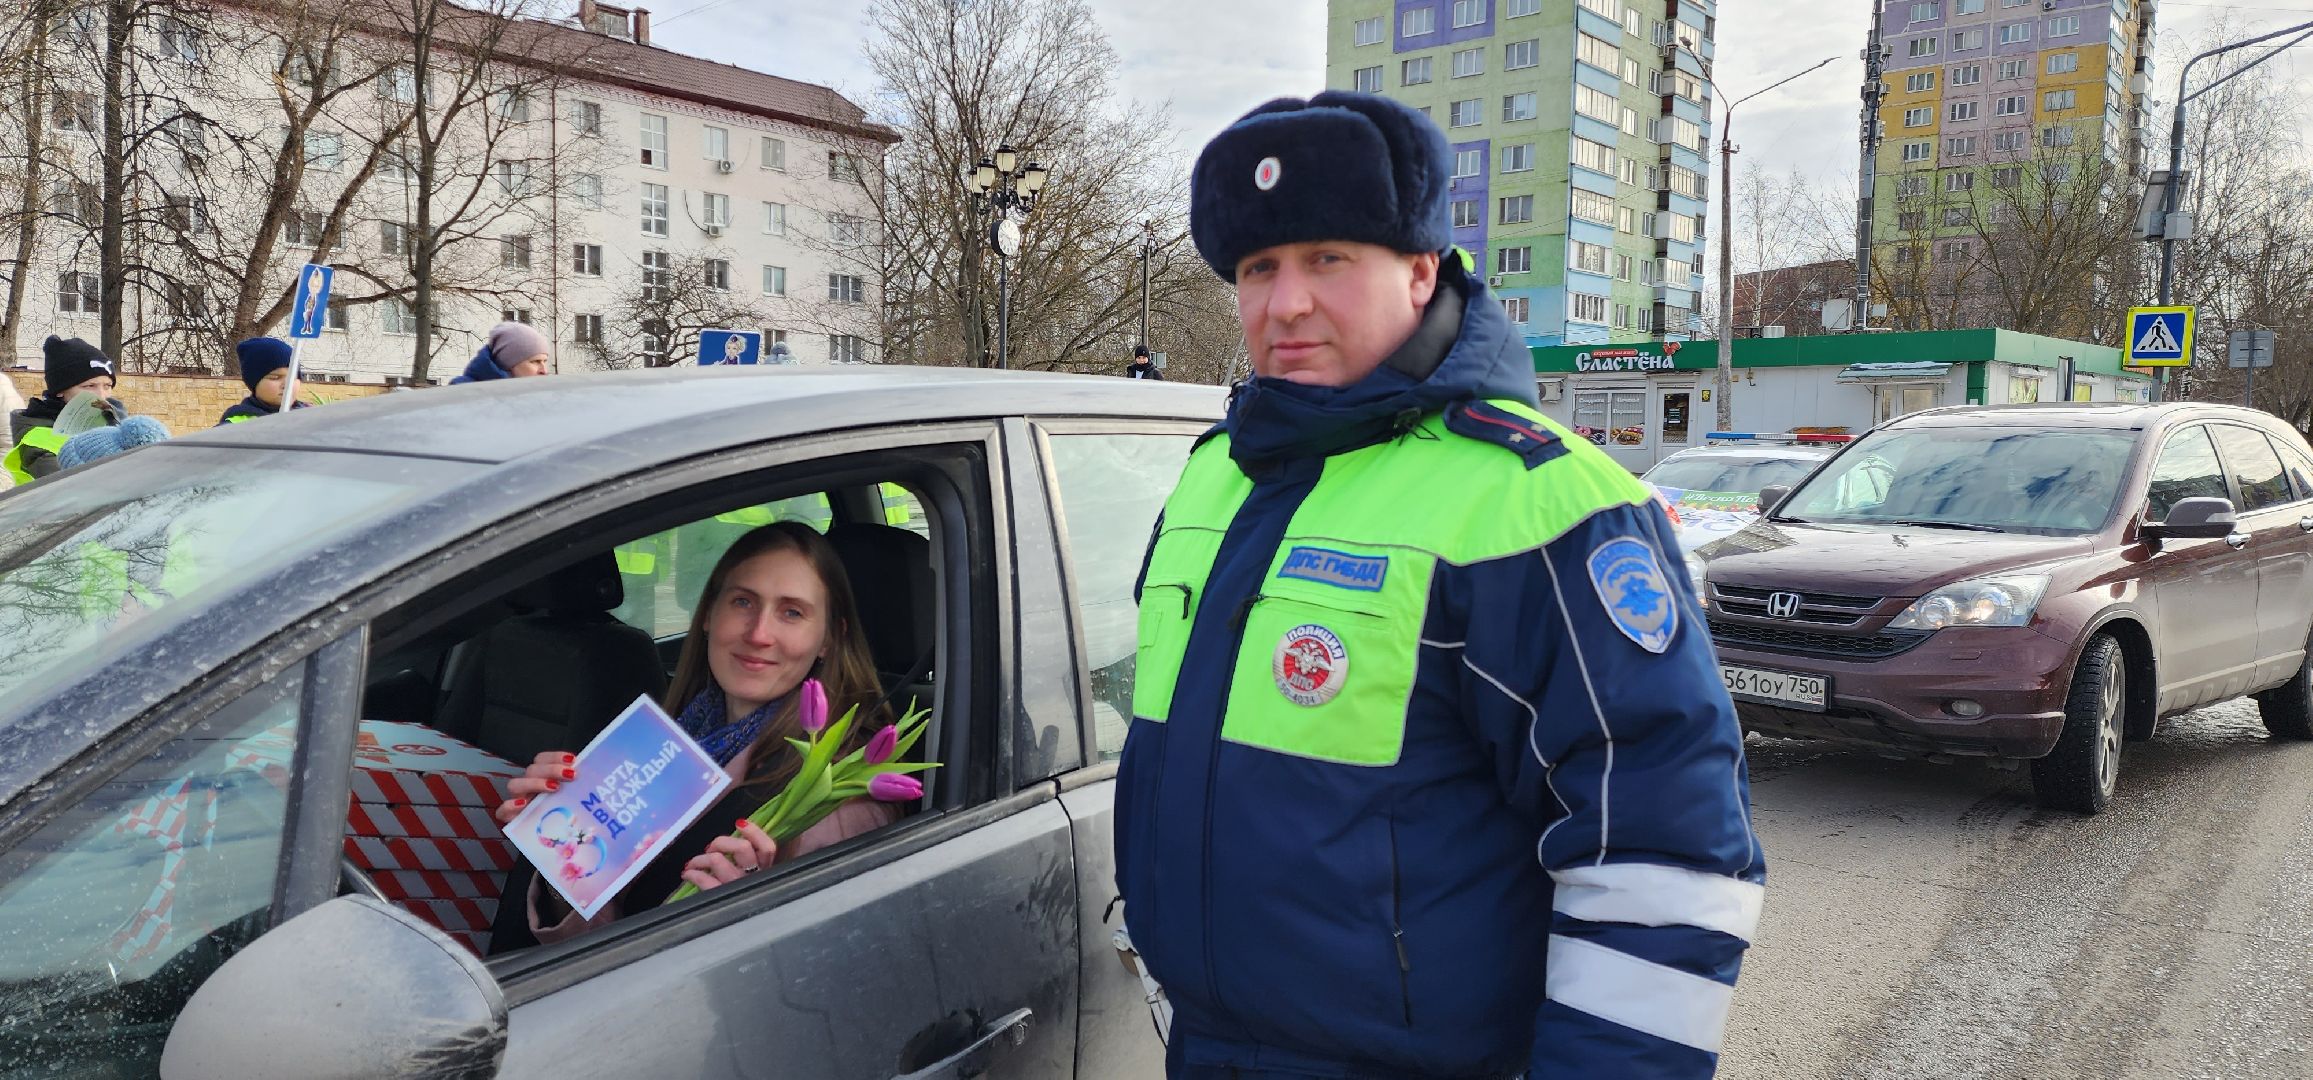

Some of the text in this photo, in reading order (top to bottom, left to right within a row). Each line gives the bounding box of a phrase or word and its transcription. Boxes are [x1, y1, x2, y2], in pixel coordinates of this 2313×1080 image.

[1575, 351, 1675, 372] Сластёна
[1287, 550, 1380, 582] ДПС ГИБДД
[1287, 625, 1344, 658] ПОЛИЦИЯ
[1290, 672, 1314, 690] ДПС
[1788, 676, 1819, 695] 750
[580, 759, 641, 812] МАРТА
[605, 739, 683, 813] КАЖДЫЙ
[607, 796, 649, 840] ДОМ
